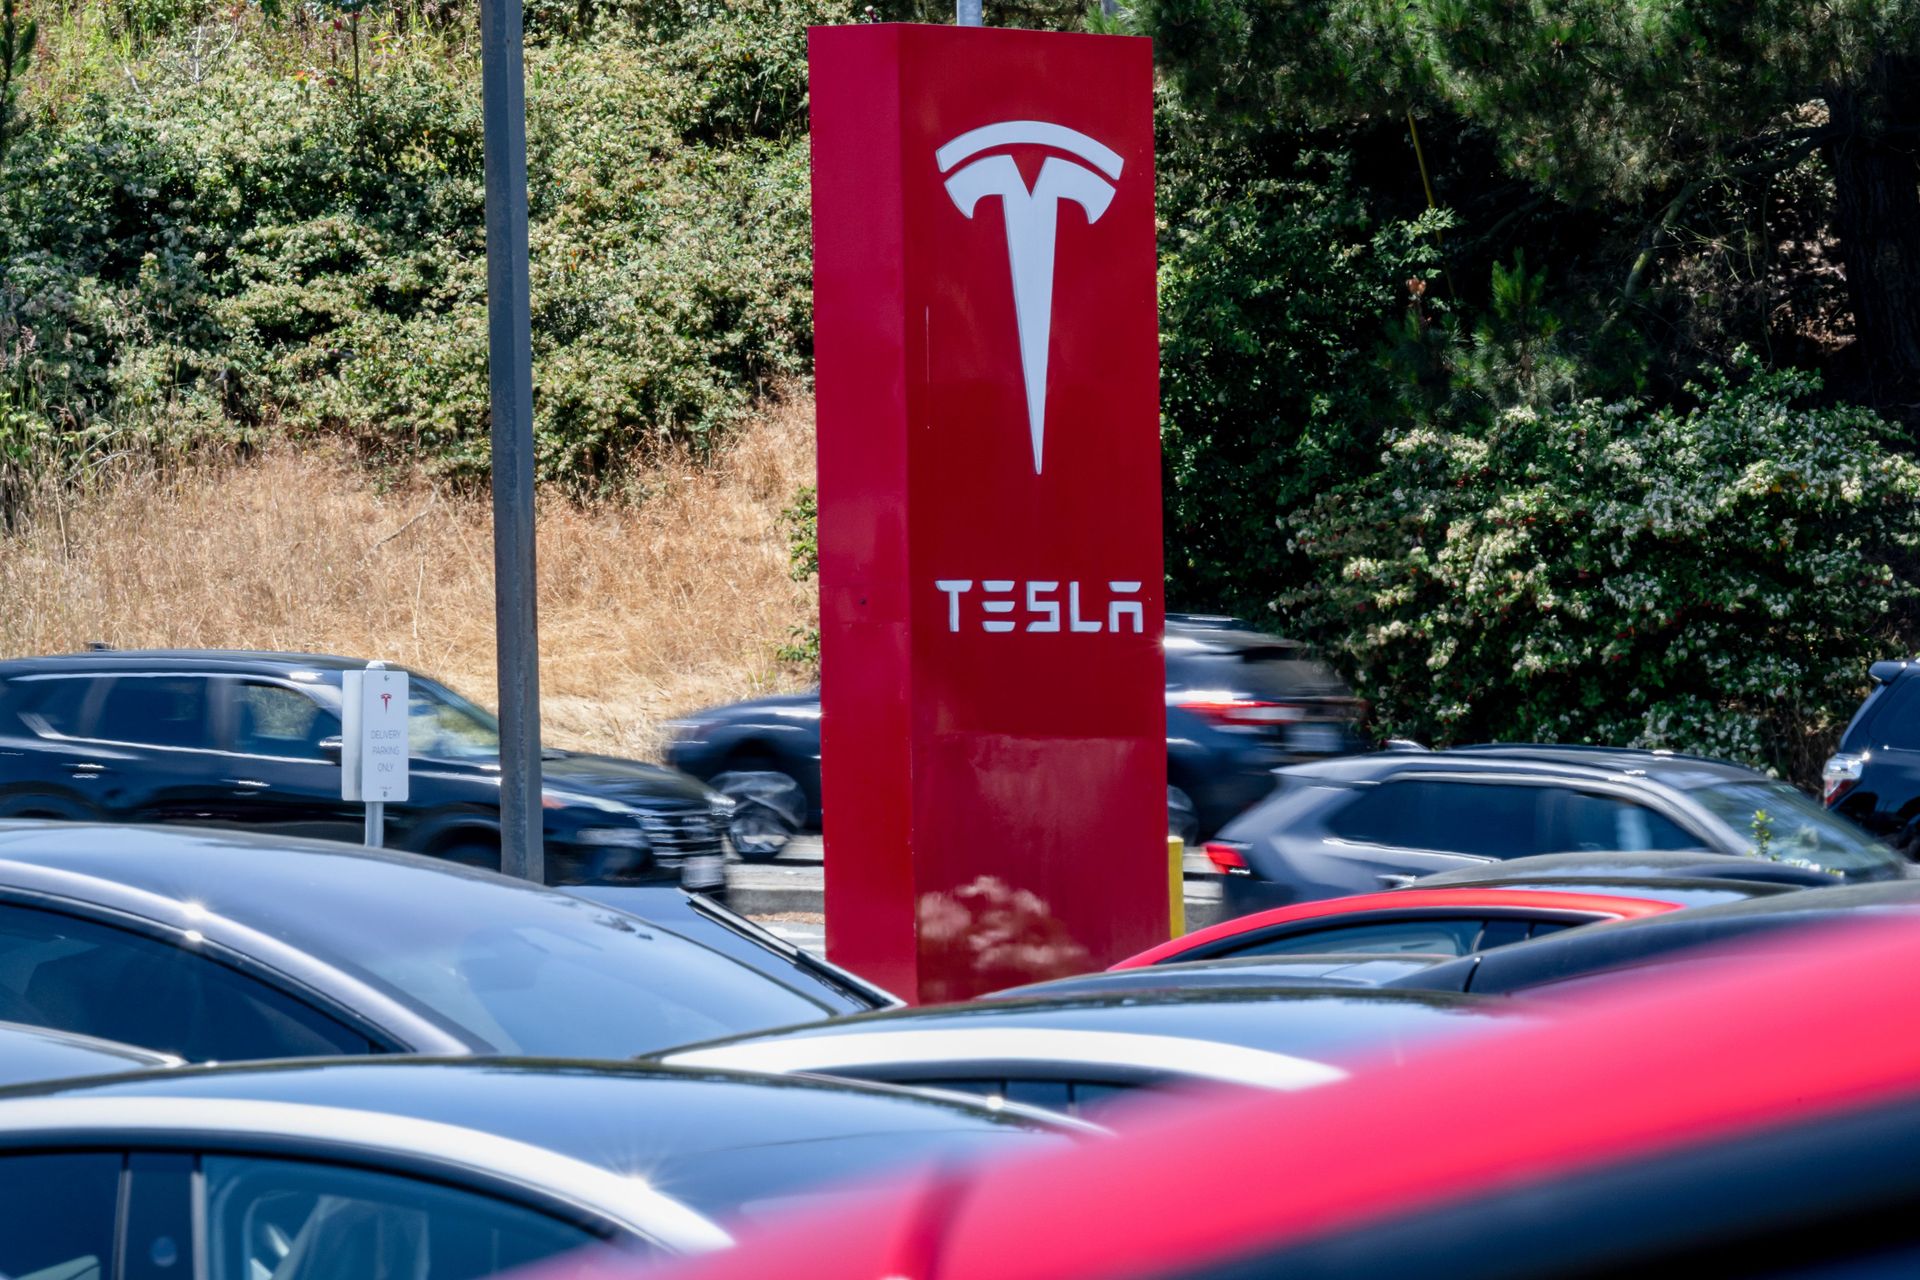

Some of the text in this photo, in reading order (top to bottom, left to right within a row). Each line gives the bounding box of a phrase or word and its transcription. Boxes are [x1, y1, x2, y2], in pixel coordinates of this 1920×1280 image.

[935, 580, 1143, 632] TESLA
[371, 730, 401, 740] DELIVERY
[372, 746, 400, 755] PARKING
[377, 763, 394, 772] ONLY
